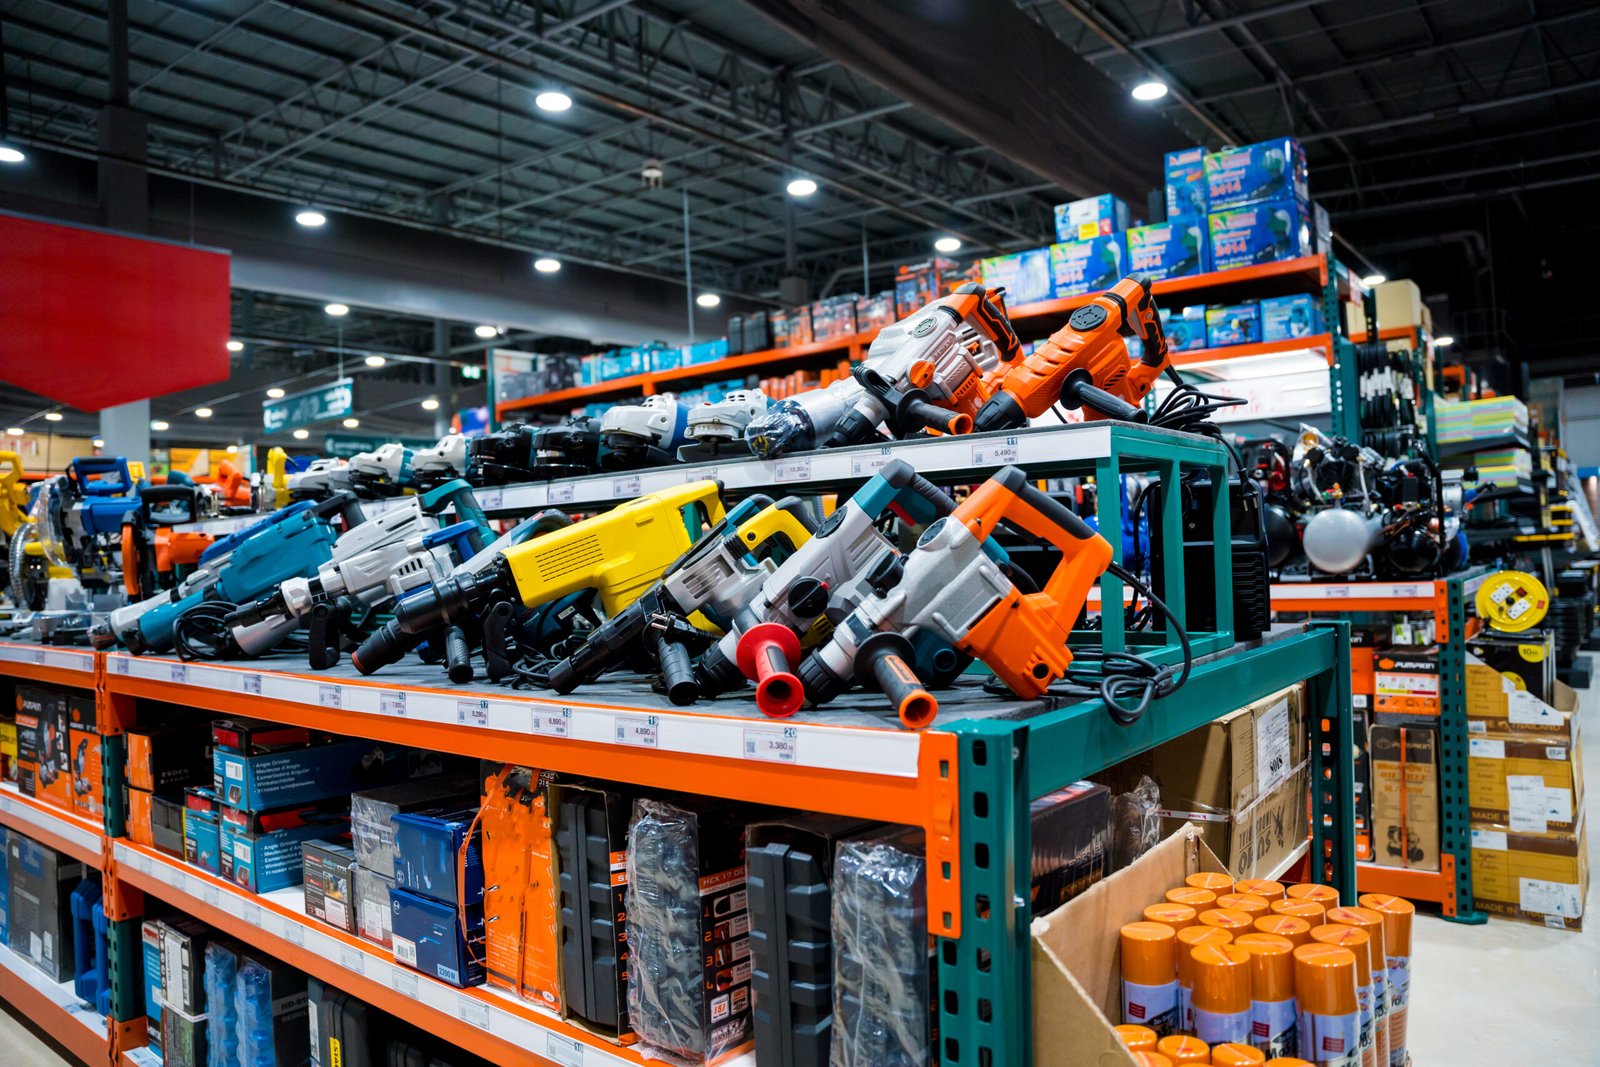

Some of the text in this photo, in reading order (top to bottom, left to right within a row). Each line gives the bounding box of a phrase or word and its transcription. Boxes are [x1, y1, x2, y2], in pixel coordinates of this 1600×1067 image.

[1007, 437, 1017, 445] 11
[1394, 661, 1434, 669] PUMPKIN
[785, 728, 797, 738] 20
[1472, 811, 1499, 819] MADE
[703, 875, 720, 886] HEX
[618, 893, 623, 902] 1
[1475, 902, 1504, 912] MADE
[618, 914, 626, 922] 2
[704, 931, 712, 942] 2
